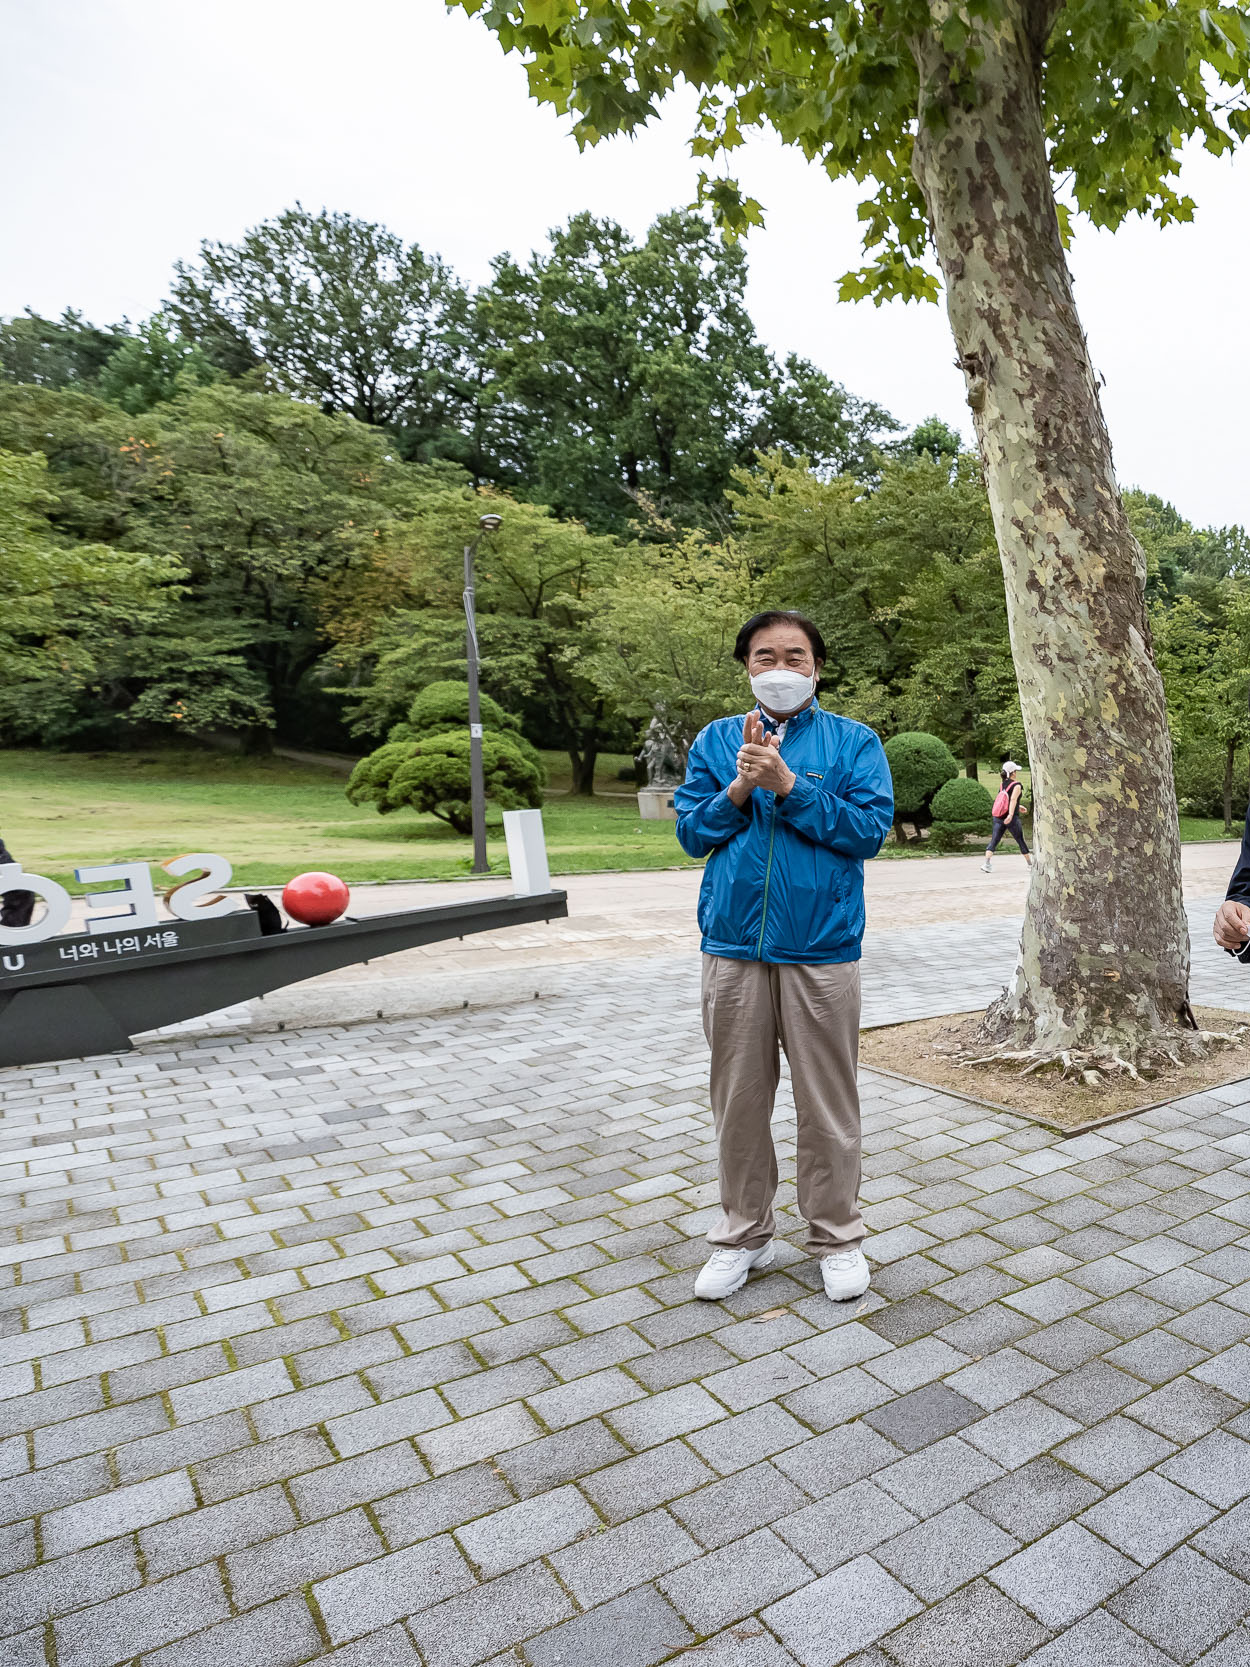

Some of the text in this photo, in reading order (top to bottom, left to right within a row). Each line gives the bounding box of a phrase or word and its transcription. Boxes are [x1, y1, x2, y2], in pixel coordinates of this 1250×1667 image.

[59, 942, 99, 962] 너와
[103, 936, 141, 955] 나의
[143, 931, 179, 950] 서울
